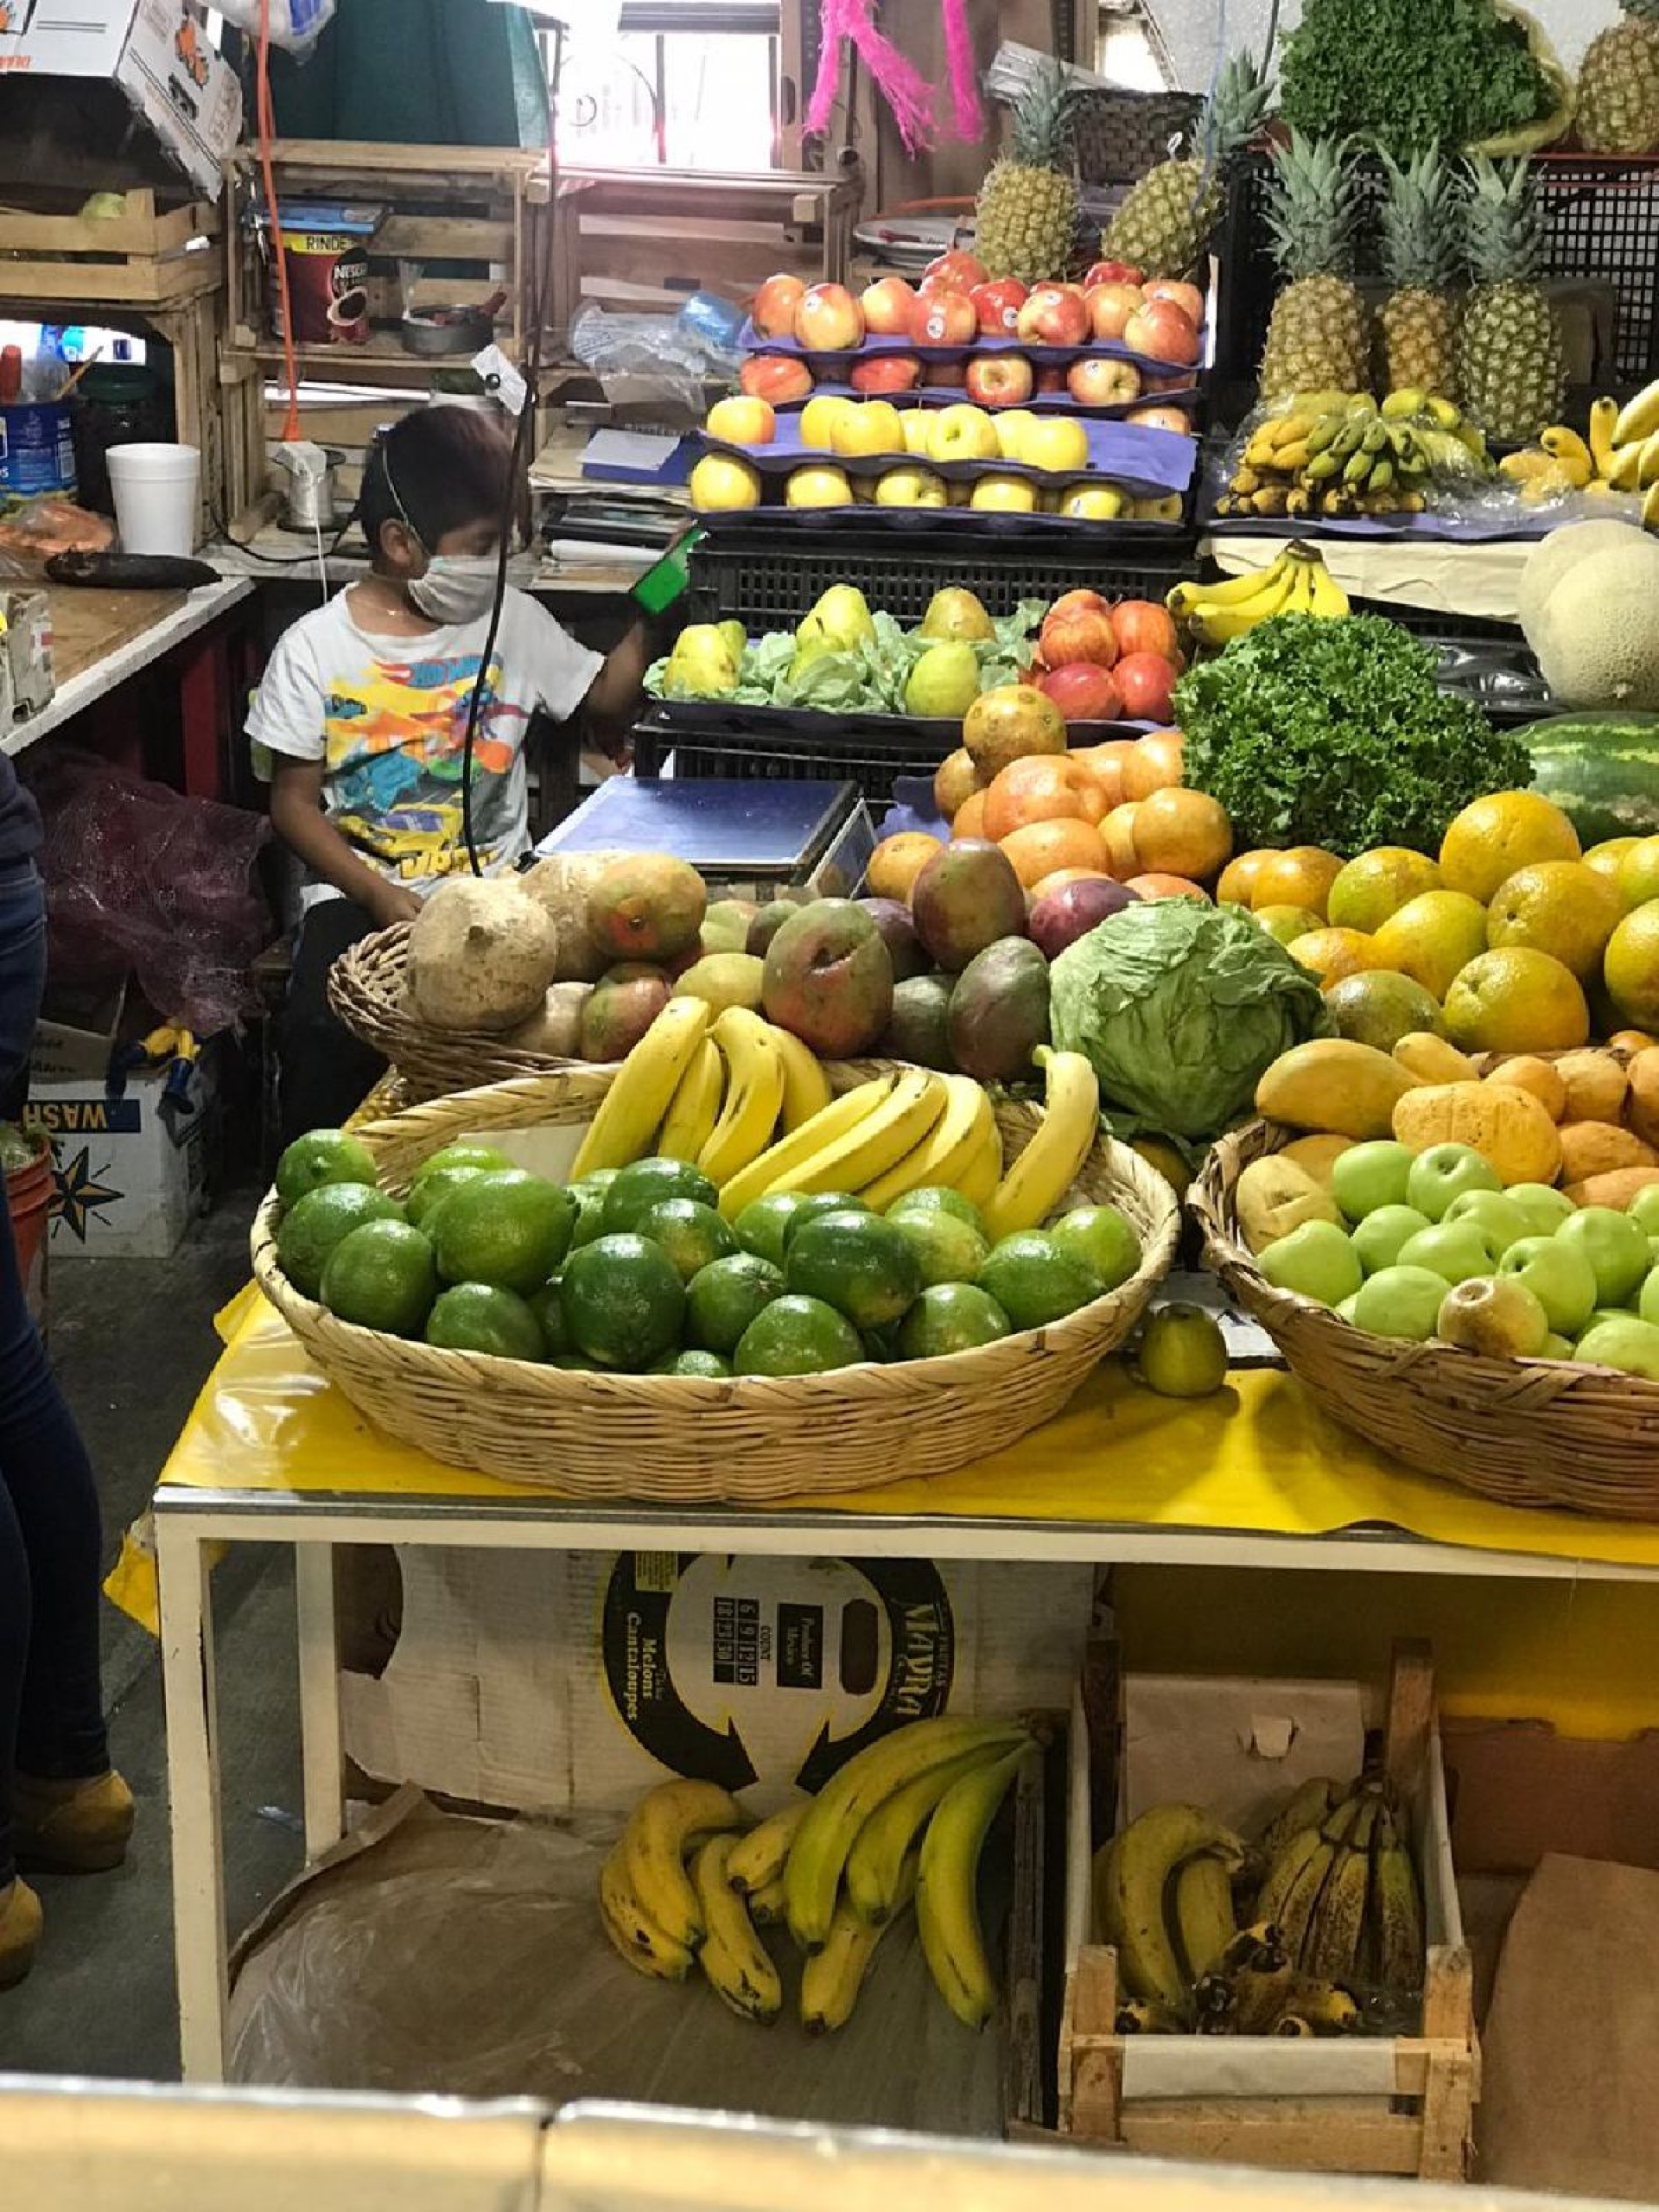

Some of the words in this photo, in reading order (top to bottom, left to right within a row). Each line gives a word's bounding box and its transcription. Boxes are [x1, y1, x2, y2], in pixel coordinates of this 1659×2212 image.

[622, 1611, 643, 1722] Cantaloupes
[642, 1637, 658, 1700] Melons
[739, 1644, 756, 1662] 12
[739, 1667, 756, 1682] 15
